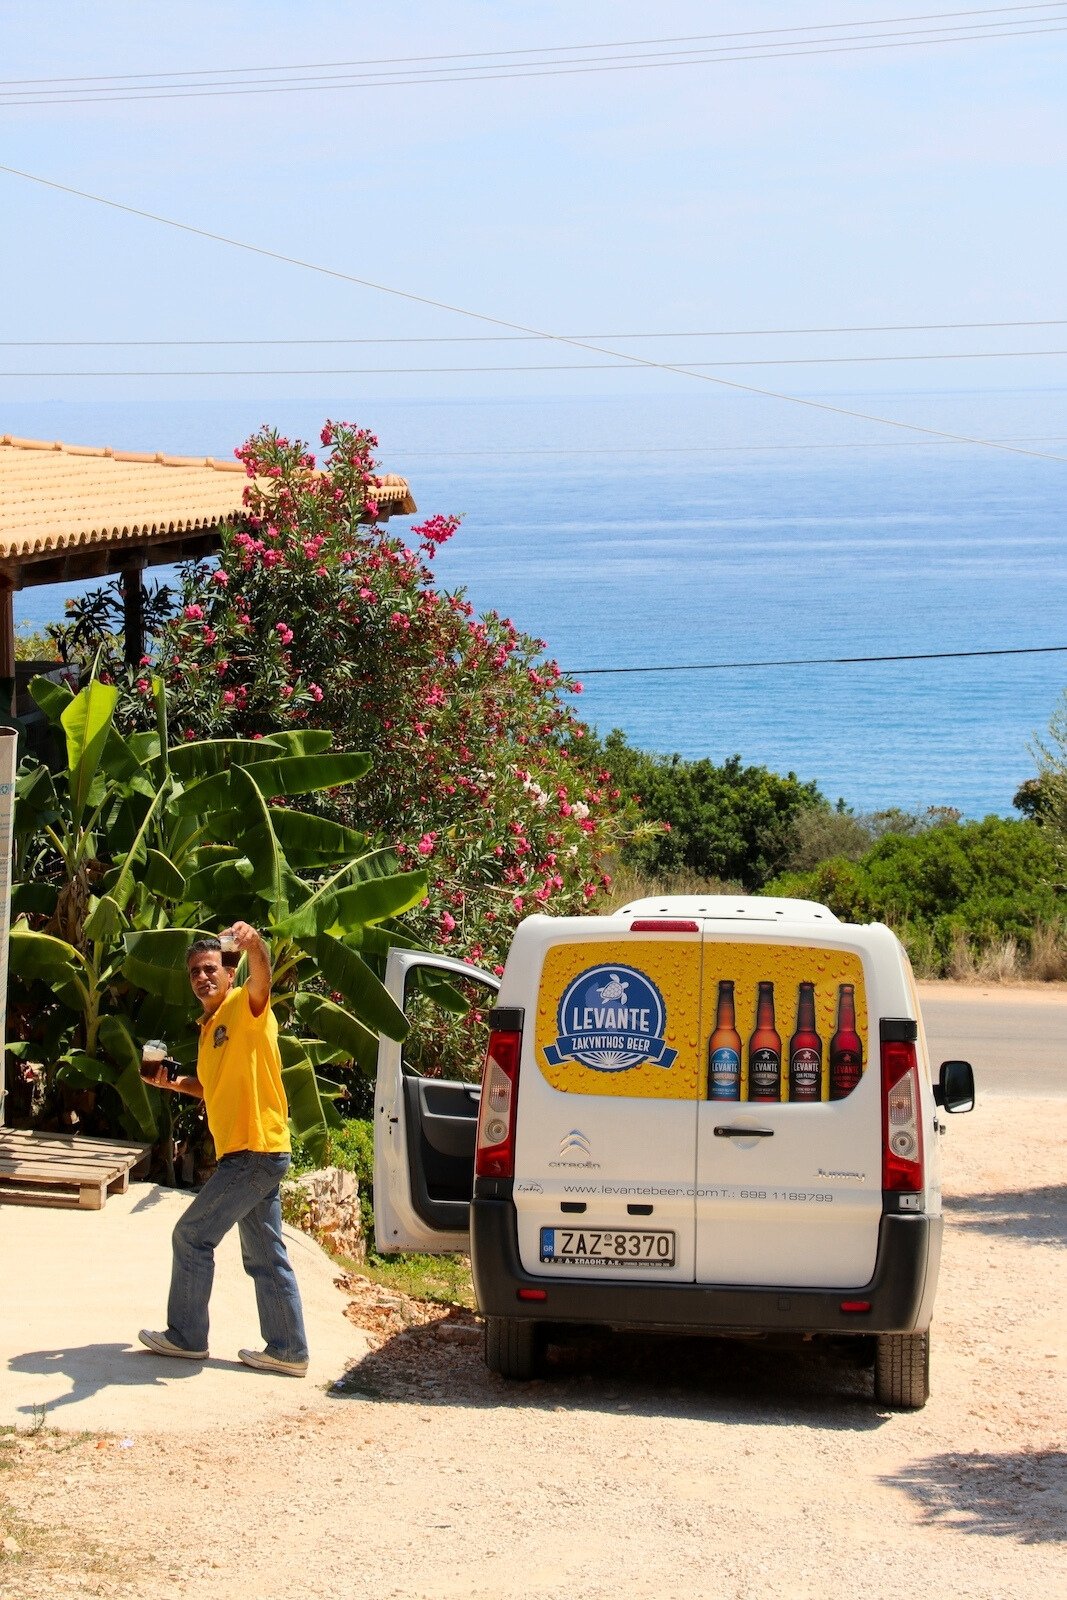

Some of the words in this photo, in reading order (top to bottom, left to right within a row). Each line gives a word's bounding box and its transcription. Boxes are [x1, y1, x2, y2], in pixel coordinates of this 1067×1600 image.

[573, 1007, 650, 1032] LEVANTE
[572, 1036, 624, 1051] ZAKYNTHOS
[627, 1038, 651, 1052] BEER
[712, 1063, 737, 1073] LEVANTE
[753, 1063, 778, 1073] LEVANTE
[793, 1063, 819, 1073] LEVANTE
[563, 1185, 719, 1197] www.levantebeer.com
[740, 1190, 767, 1199] 698
[773, 1191, 833, 1203] 1189799
[561, 1233, 670, 1257] ZAZ-8370
